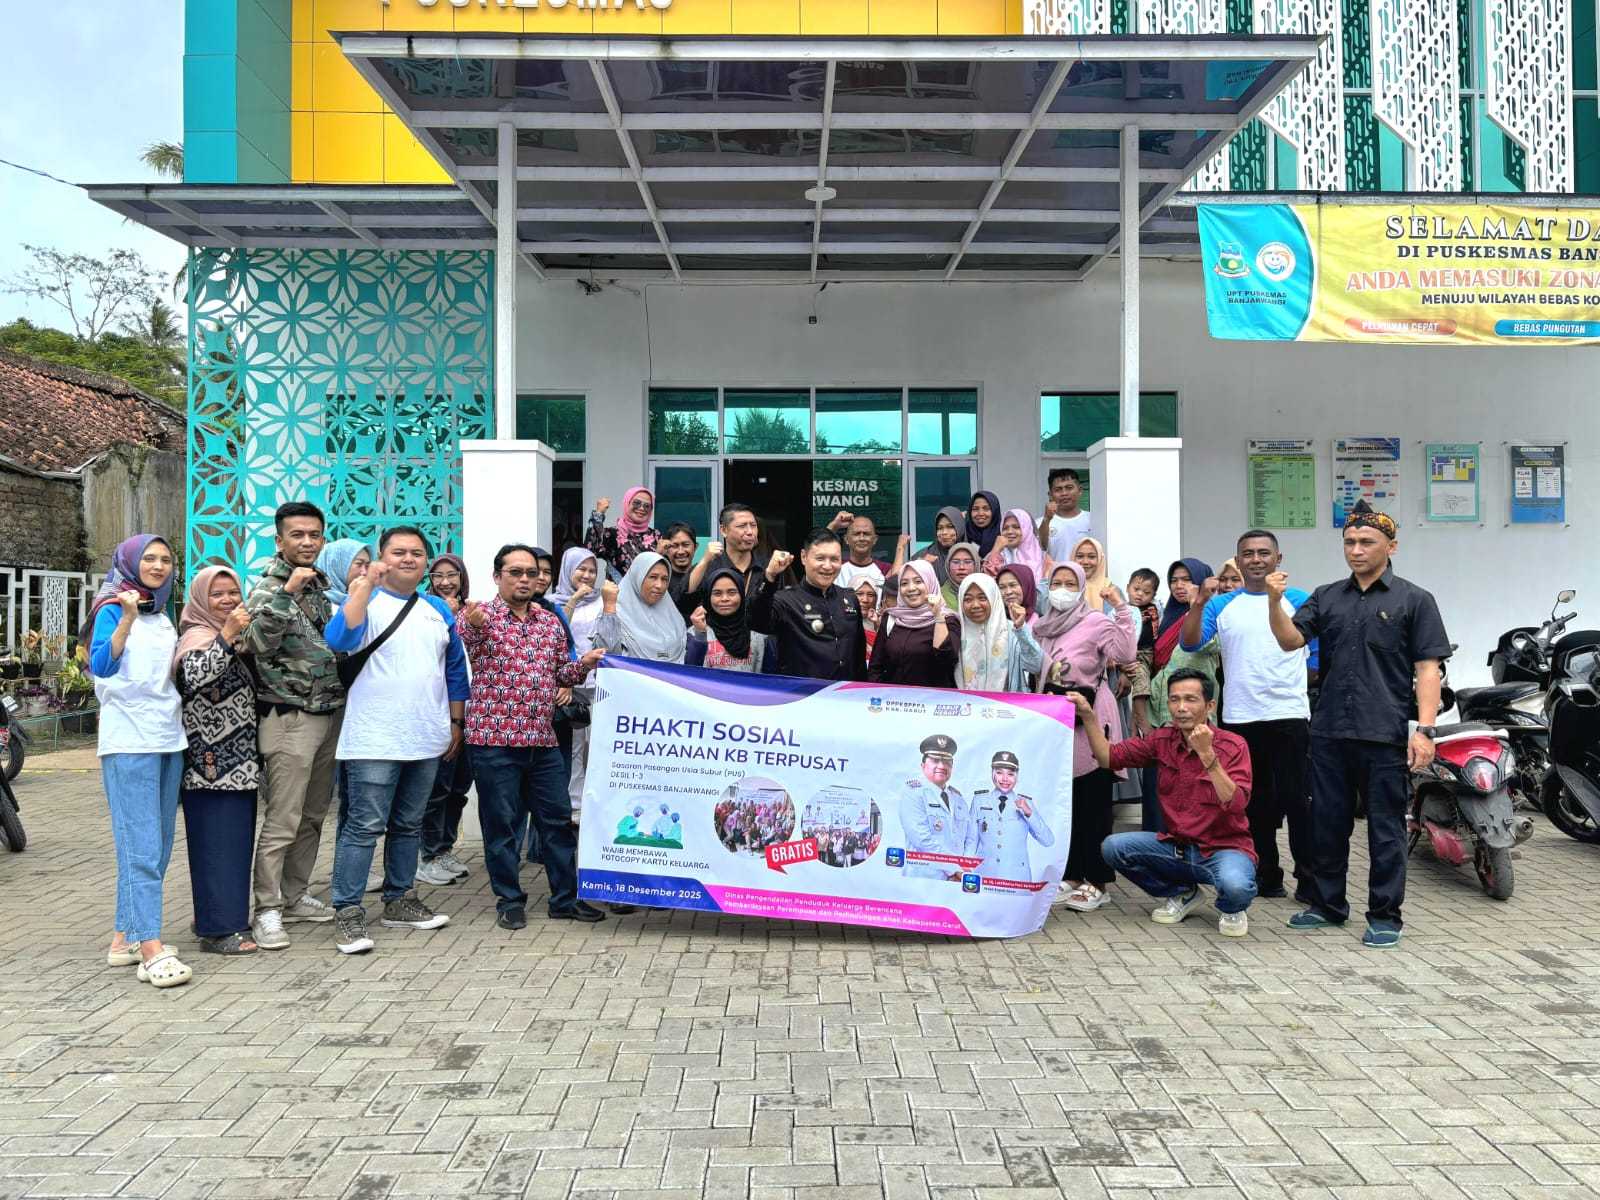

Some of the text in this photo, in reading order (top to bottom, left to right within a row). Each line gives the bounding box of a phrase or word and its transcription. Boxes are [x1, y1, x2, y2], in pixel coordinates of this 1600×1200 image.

[1385, 215, 1558, 240] SELAMAT
[1397, 245, 1600, 261] DI PUSKESMAS BAN
[1346, 270, 1412, 290] ANDA
[1419, 269, 1541, 289] MEMASUKI
[1422, 293, 1600, 306] MENUJU WILAYAH BEBAS KO
[1513, 322, 1585, 334] BEBAS PUNGUTAN
[813, 480, 879, 492] KESMAS
[615, 715, 801, 747] BHAKTI SOSIAL
[612, 740, 849, 772] PELAYANAN KB TERPUSAT
[610, 771, 630, 780] DESIL
[611, 761, 746, 778] Sasaran Pasangan Usia Subur (PUS)
[618, 782, 662, 792] PUSKESMAS
[663, 785, 720, 796] BANJARWANGI
[626, 848, 668, 858] MEMBAWA
[771, 841, 814, 863] GRATIS
[601, 854, 710, 870] FOTOCOPY KARTU KELUARGA
[582, 881, 702, 899] Kamis, 18 Desember 2025
